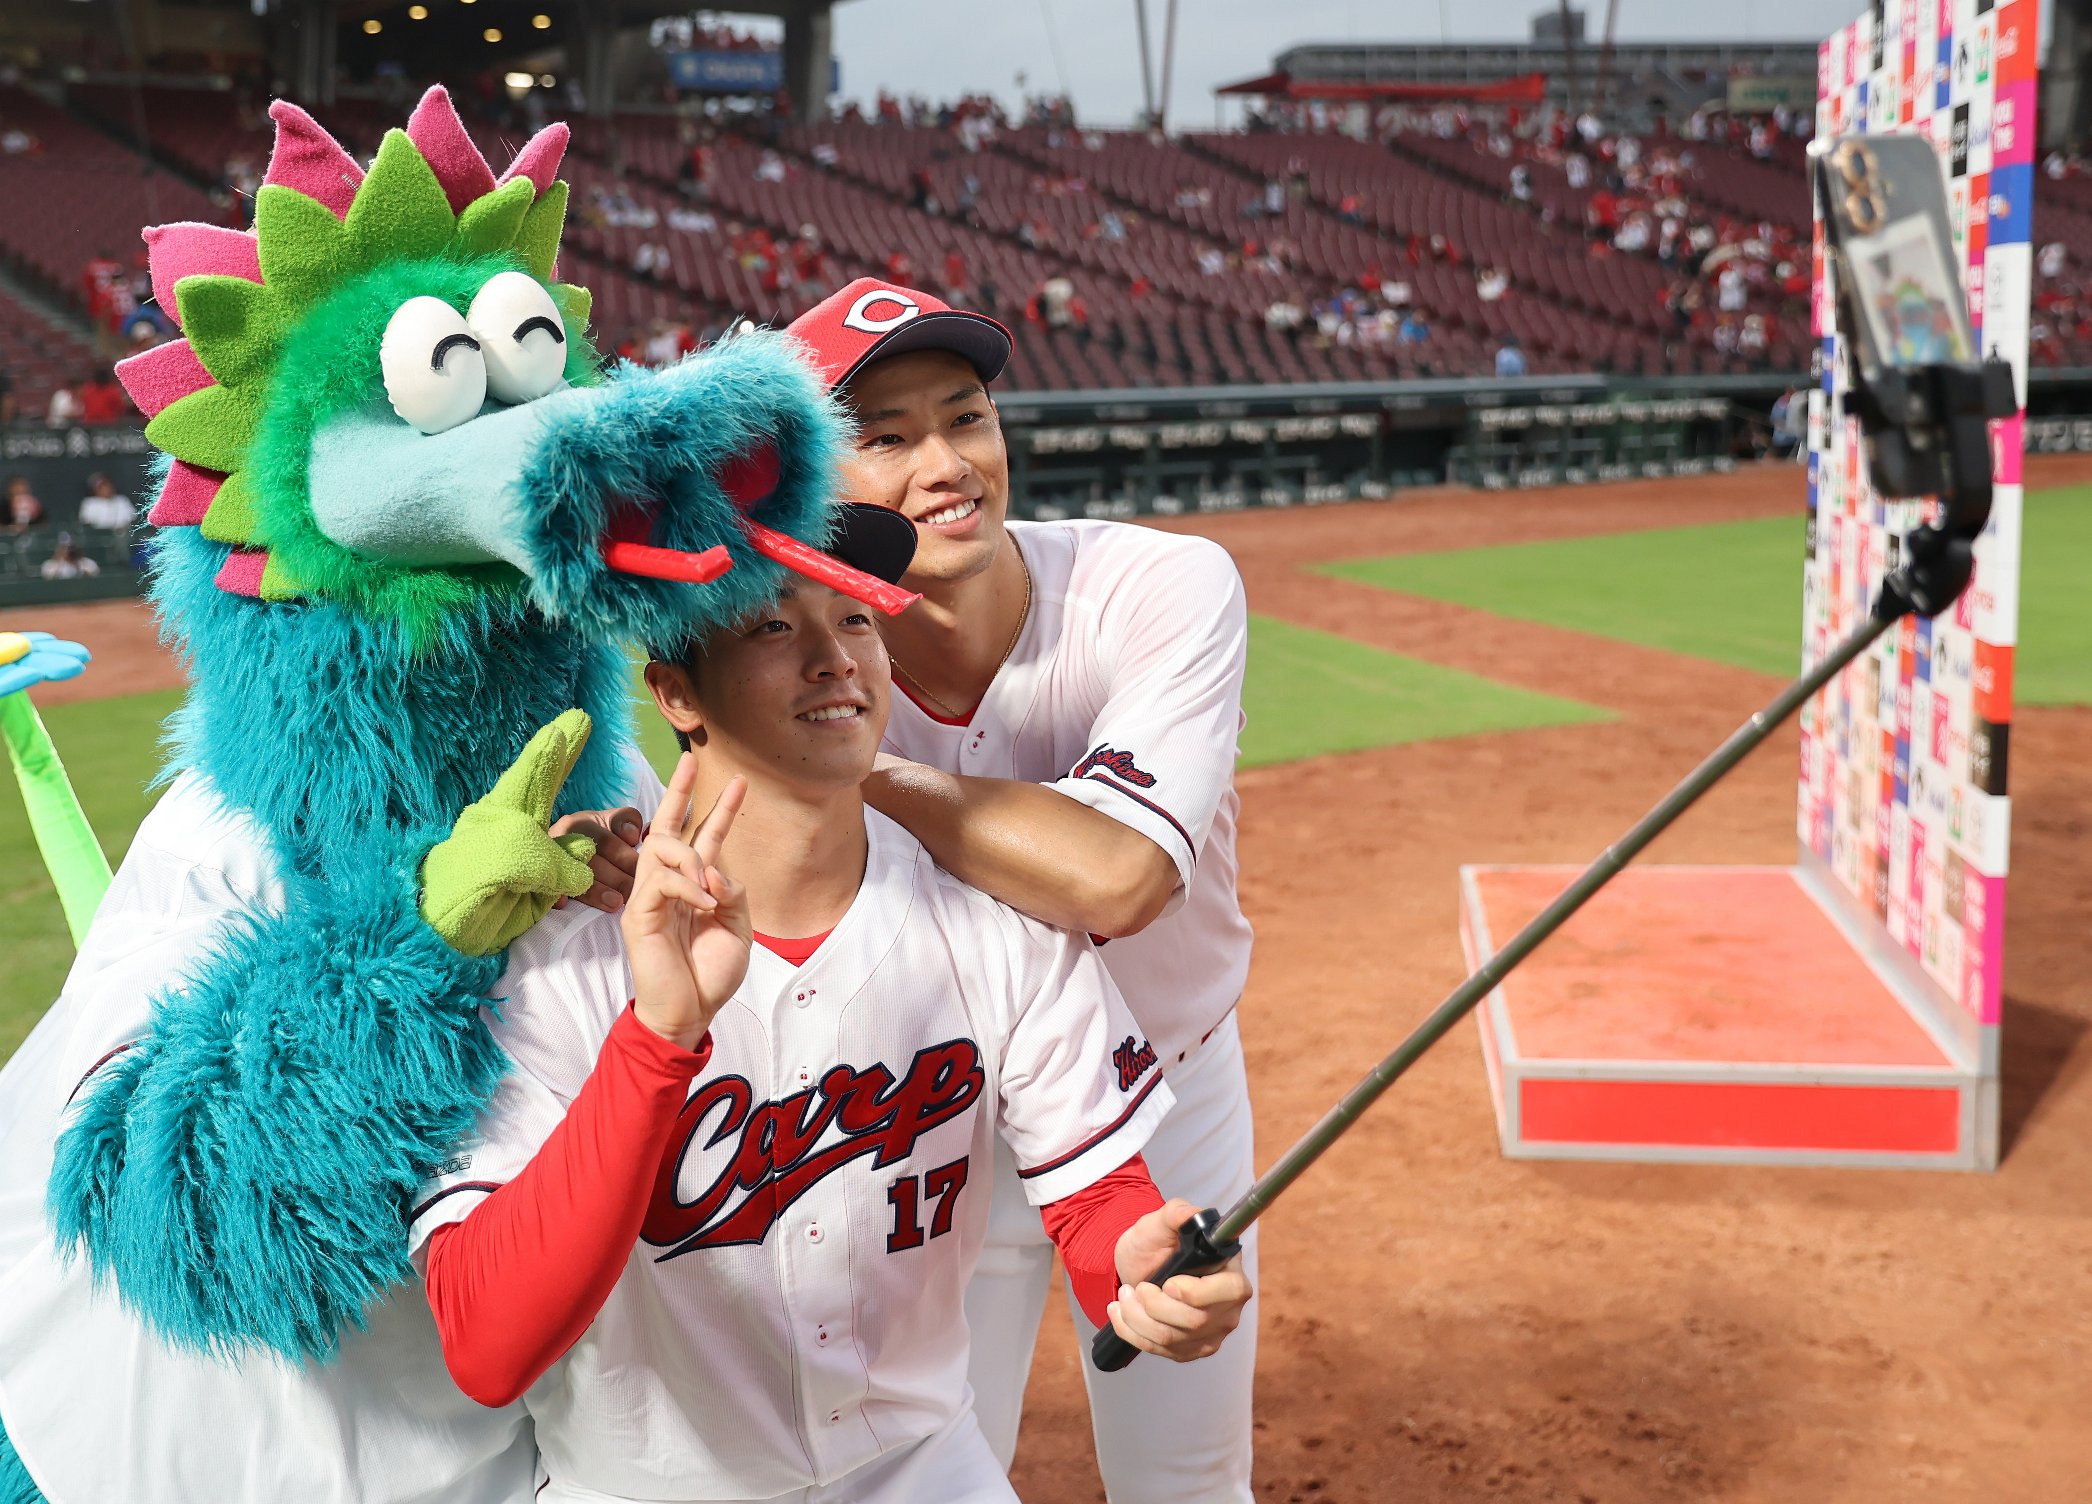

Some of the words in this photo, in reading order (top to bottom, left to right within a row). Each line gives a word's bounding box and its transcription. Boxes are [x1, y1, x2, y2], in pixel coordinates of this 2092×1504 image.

[842, 289, 920, 334] C
[640, 1038, 985, 1263] Carp
[887, 1154, 969, 1255] 17
